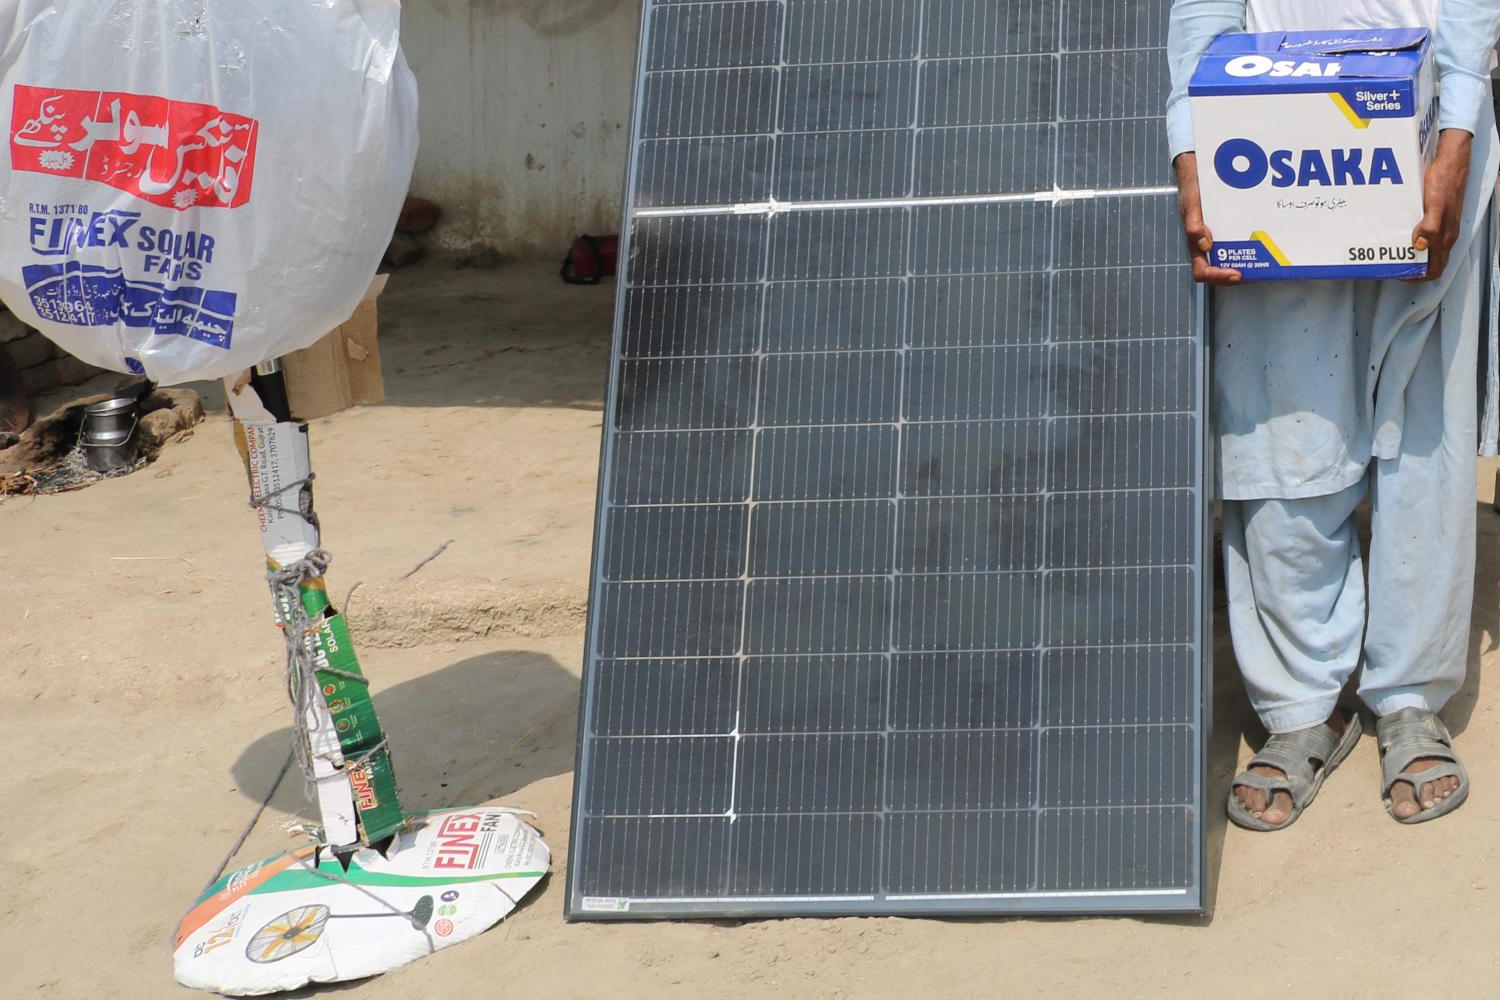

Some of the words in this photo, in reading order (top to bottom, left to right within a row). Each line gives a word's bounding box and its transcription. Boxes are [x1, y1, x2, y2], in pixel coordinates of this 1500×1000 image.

[1366, 101, 1401, 111] Series
[1214, 138, 1404, 189] OSAKA
[29, 202, 50, 215] R.T.M.
[29, 209, 141, 255] FINEX
[137, 225, 215, 263] SOLAR
[1216, 248, 1227, 261] 9
[1349, 247, 1375, 261] S80
[1379, 246, 1416, 260] PLUS
[143, 256, 203, 282] FANS
[250, 460, 262, 498] ELECTRIC
[255, 504, 268, 533] CHEEM
[480, 813, 501, 832] FAN
[434, 814, 481, 870] FINEX
